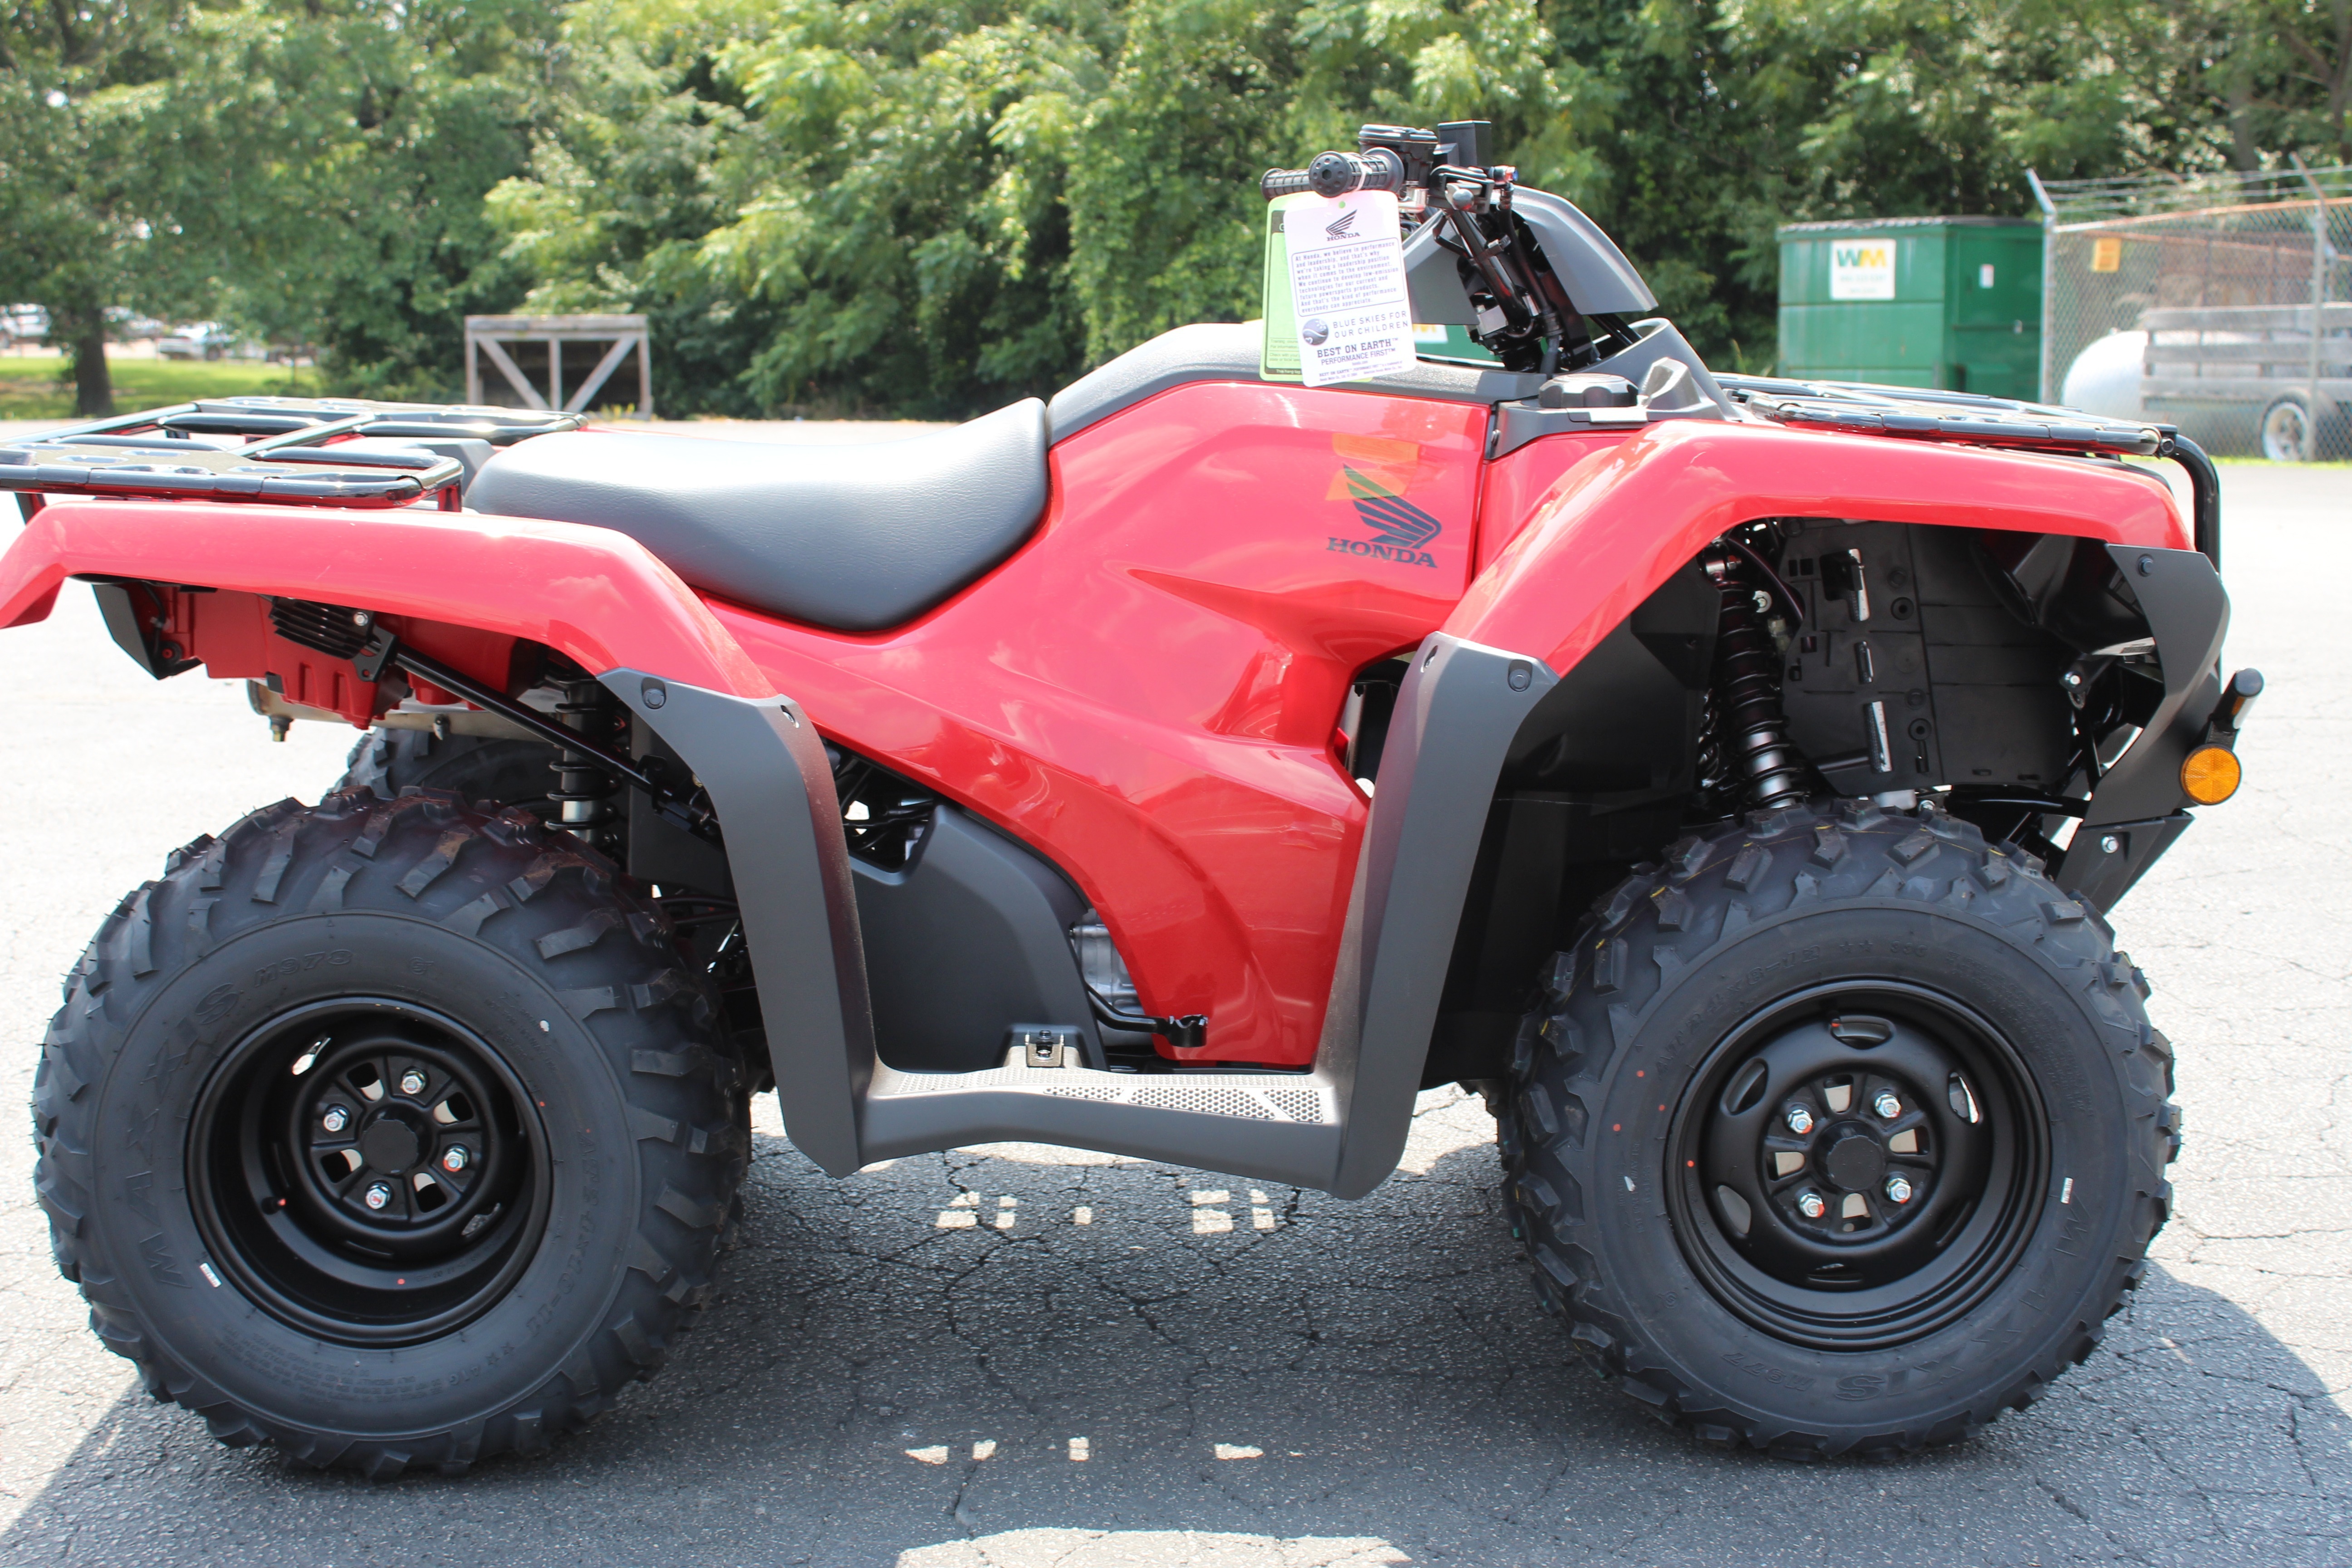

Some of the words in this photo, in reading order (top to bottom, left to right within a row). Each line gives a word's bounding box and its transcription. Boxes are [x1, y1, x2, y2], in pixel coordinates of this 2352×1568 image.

[1327, 232, 1360, 242] HONDA
[1361, 242, 1394, 251] performance
[1837, 248, 1886, 267] WM
[1357, 262, 1392, 271] environment.
[1363, 268, 1398, 276] low-emission
[1299, 284, 1333, 294] technologies
[1319, 288, 1352, 298] powersports
[1354, 284, 1378, 292] products.
[1363, 288, 1396, 297] performance
[1302, 305, 1328, 313] everybody
[1333, 318, 1356, 328] BLUE
[1359, 314, 1386, 324] SKIES
[1389, 311, 1406, 319] FOR
[1335, 329, 1354, 338] OUR
[1358, 321, 1408, 334] CHILDREN
[1317, 347, 1341, 358] BEST
[1345, 344, 1357, 353] ON
[1321, 352, 1368, 365] PERFORMANCE
[1325, 537, 1438, 568] HONDA
[253, 949, 354, 996] M978
[1722, 1350, 1812, 1394] M977
